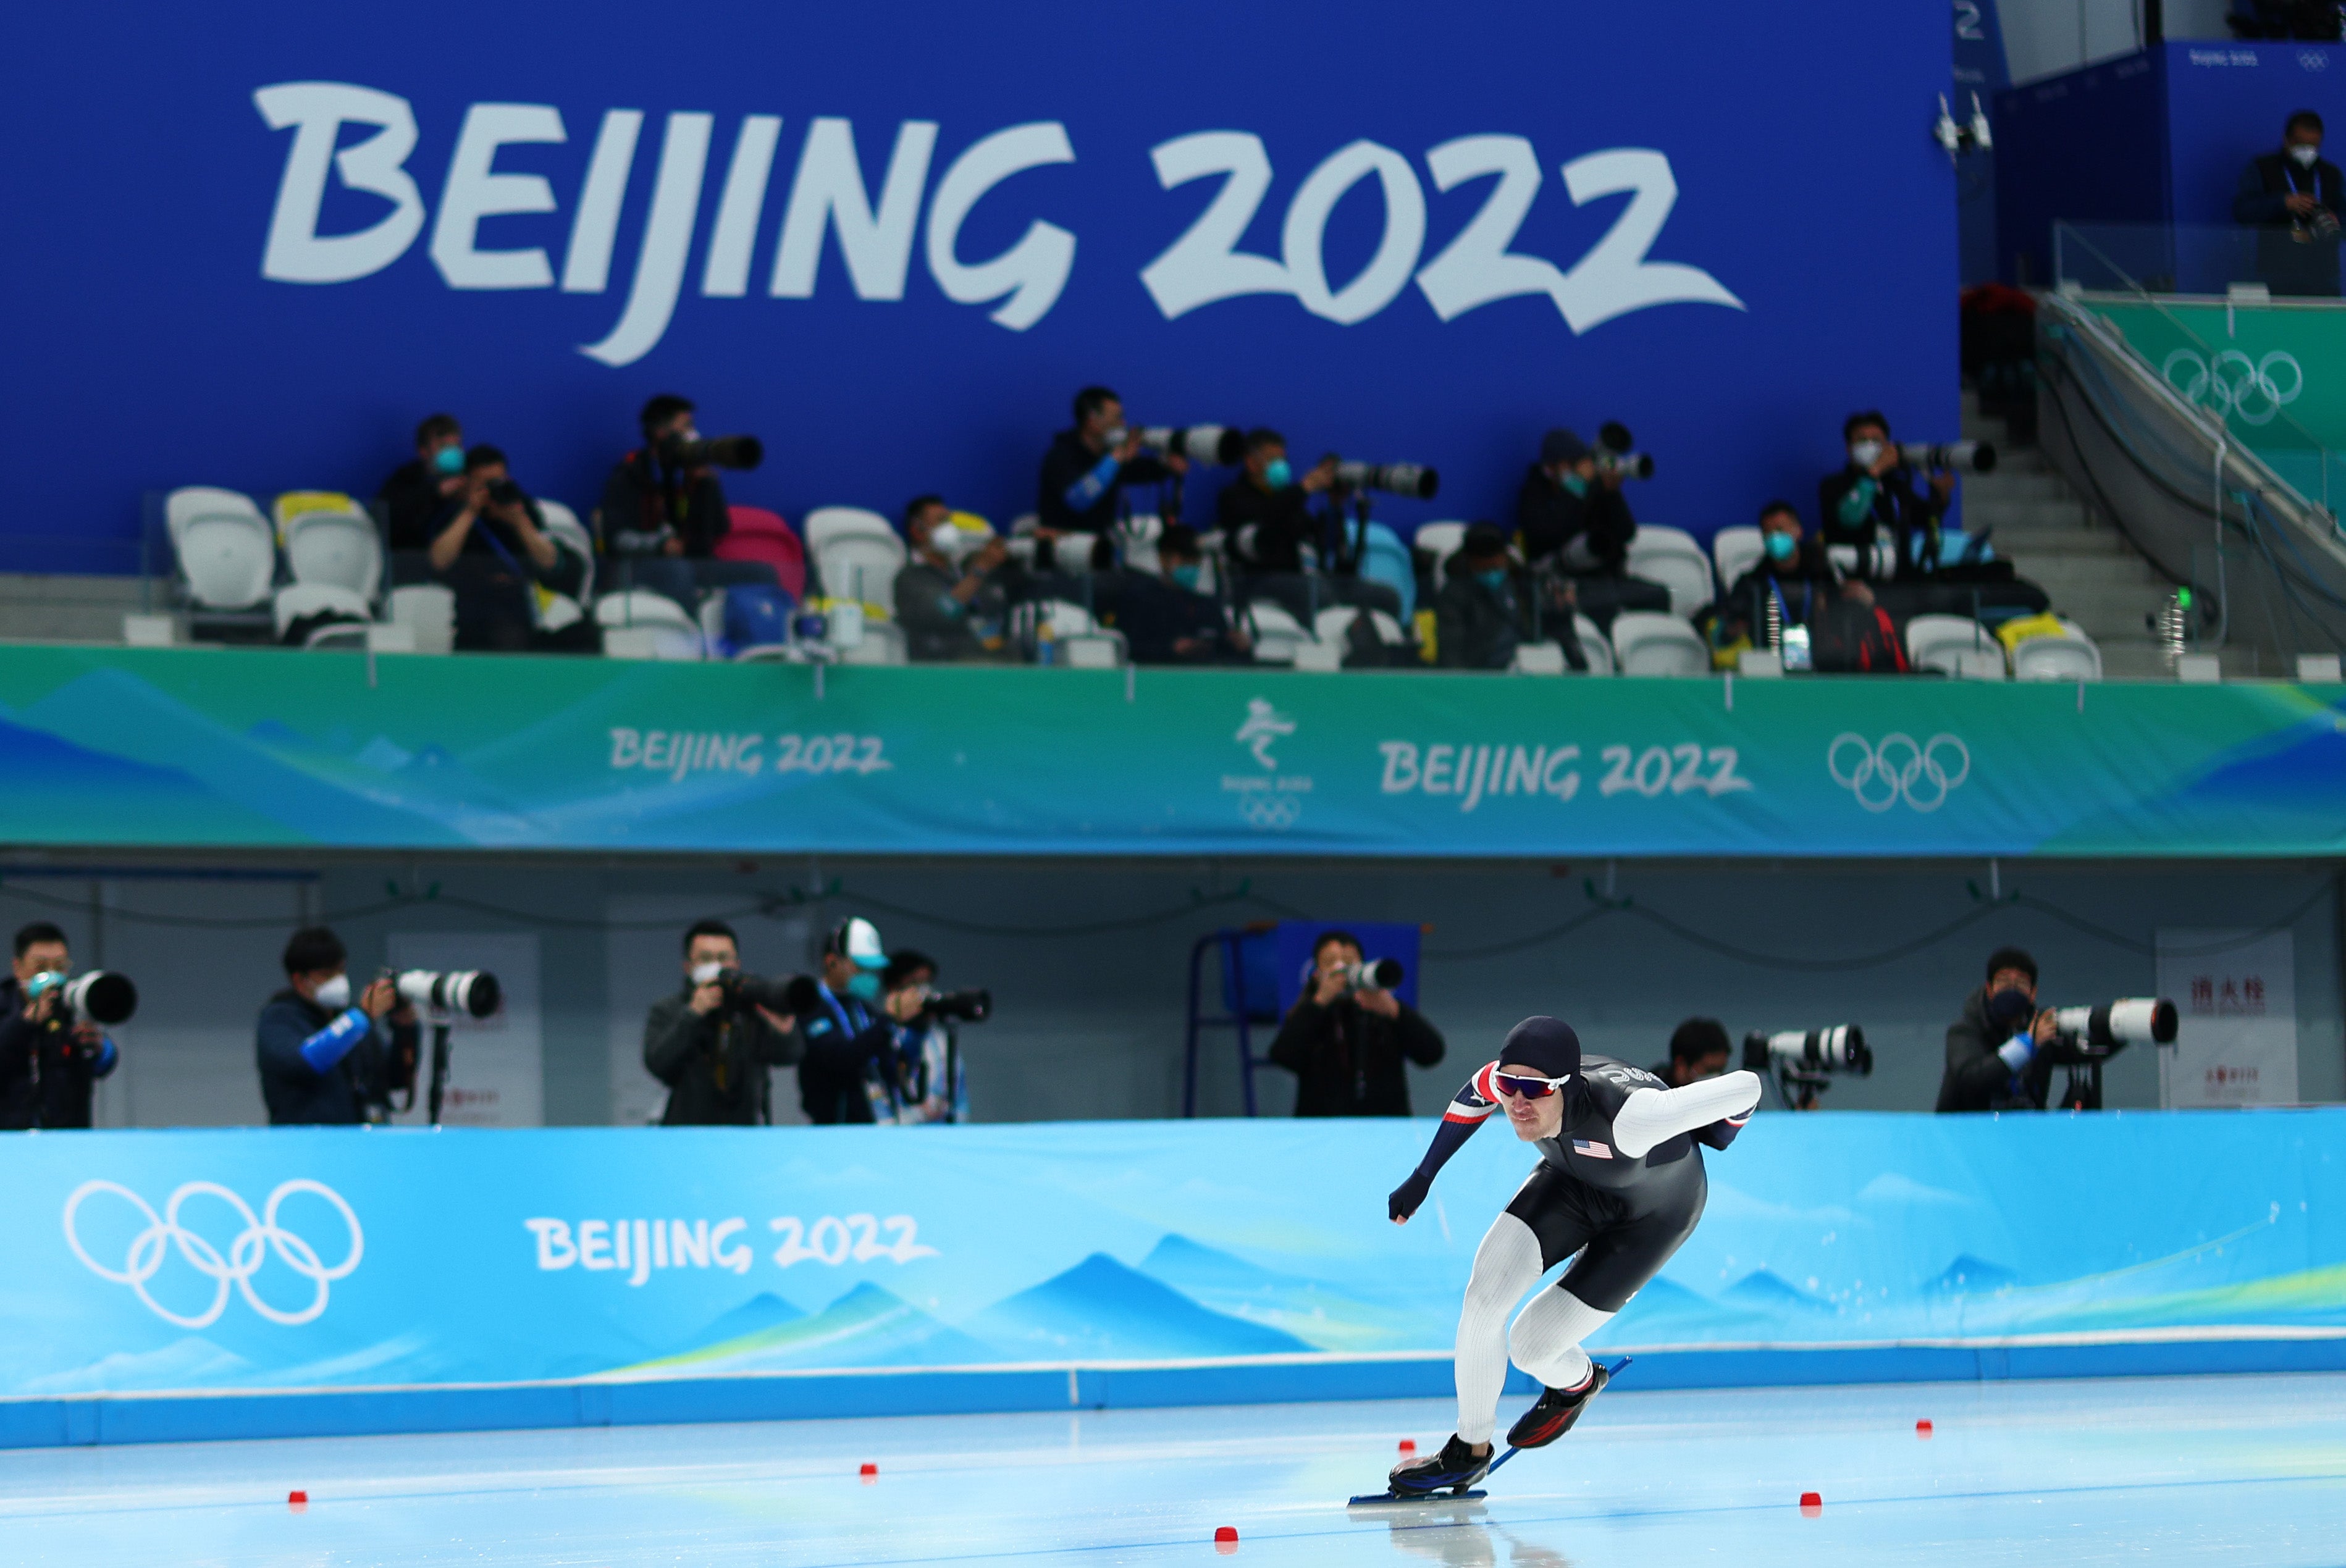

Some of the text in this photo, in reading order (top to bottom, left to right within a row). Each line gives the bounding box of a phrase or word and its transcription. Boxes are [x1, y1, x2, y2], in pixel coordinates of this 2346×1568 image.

[253, 82, 1746, 366] BEIJING 2022
[608, 727, 893, 785] BEIJING 2022
[1378, 740, 1752, 813] BEIJING 2022
[524, 1211, 943, 1287] BEIJING 2022
